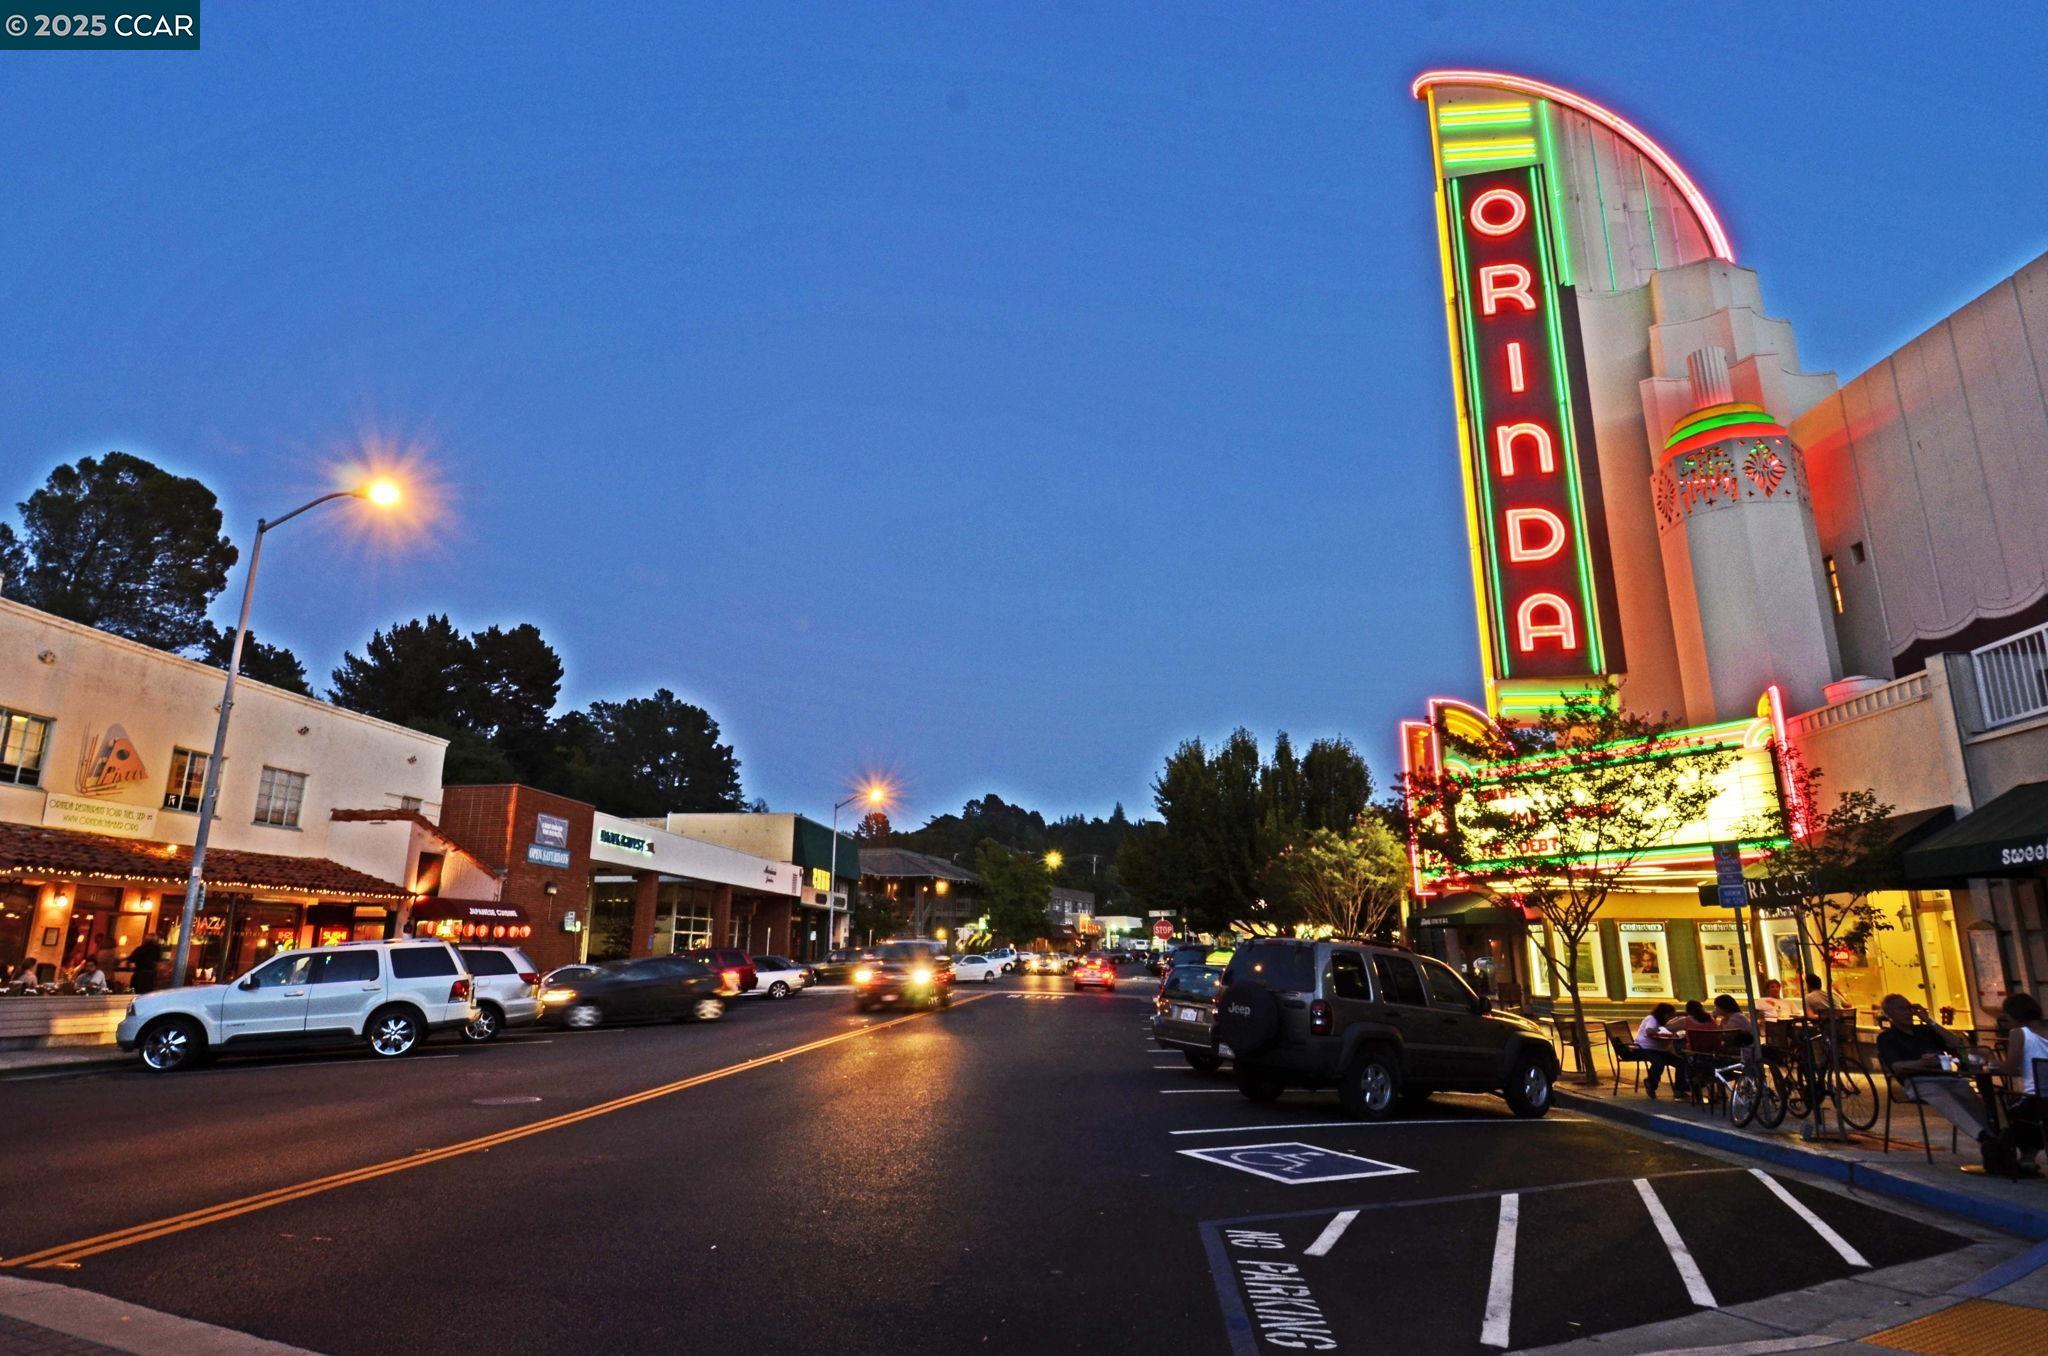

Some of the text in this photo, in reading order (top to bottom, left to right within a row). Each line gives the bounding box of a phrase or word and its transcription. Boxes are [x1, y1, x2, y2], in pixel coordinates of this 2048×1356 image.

[1519, 836, 1560, 853] DEBT
[529, 847, 543, 860] OPEN
[2002, 843, 2048, 865] swee
[469, 908, 497, 916] JAPANESE
[323, 931, 347, 940] SUSHI
[1154, 926, 1173, 935] STOP
[1228, 1002, 1251, 1016] Jeep
[1225, 1230, 1286, 1249] NO
[1237, 1260, 1338, 1350] PARKING
